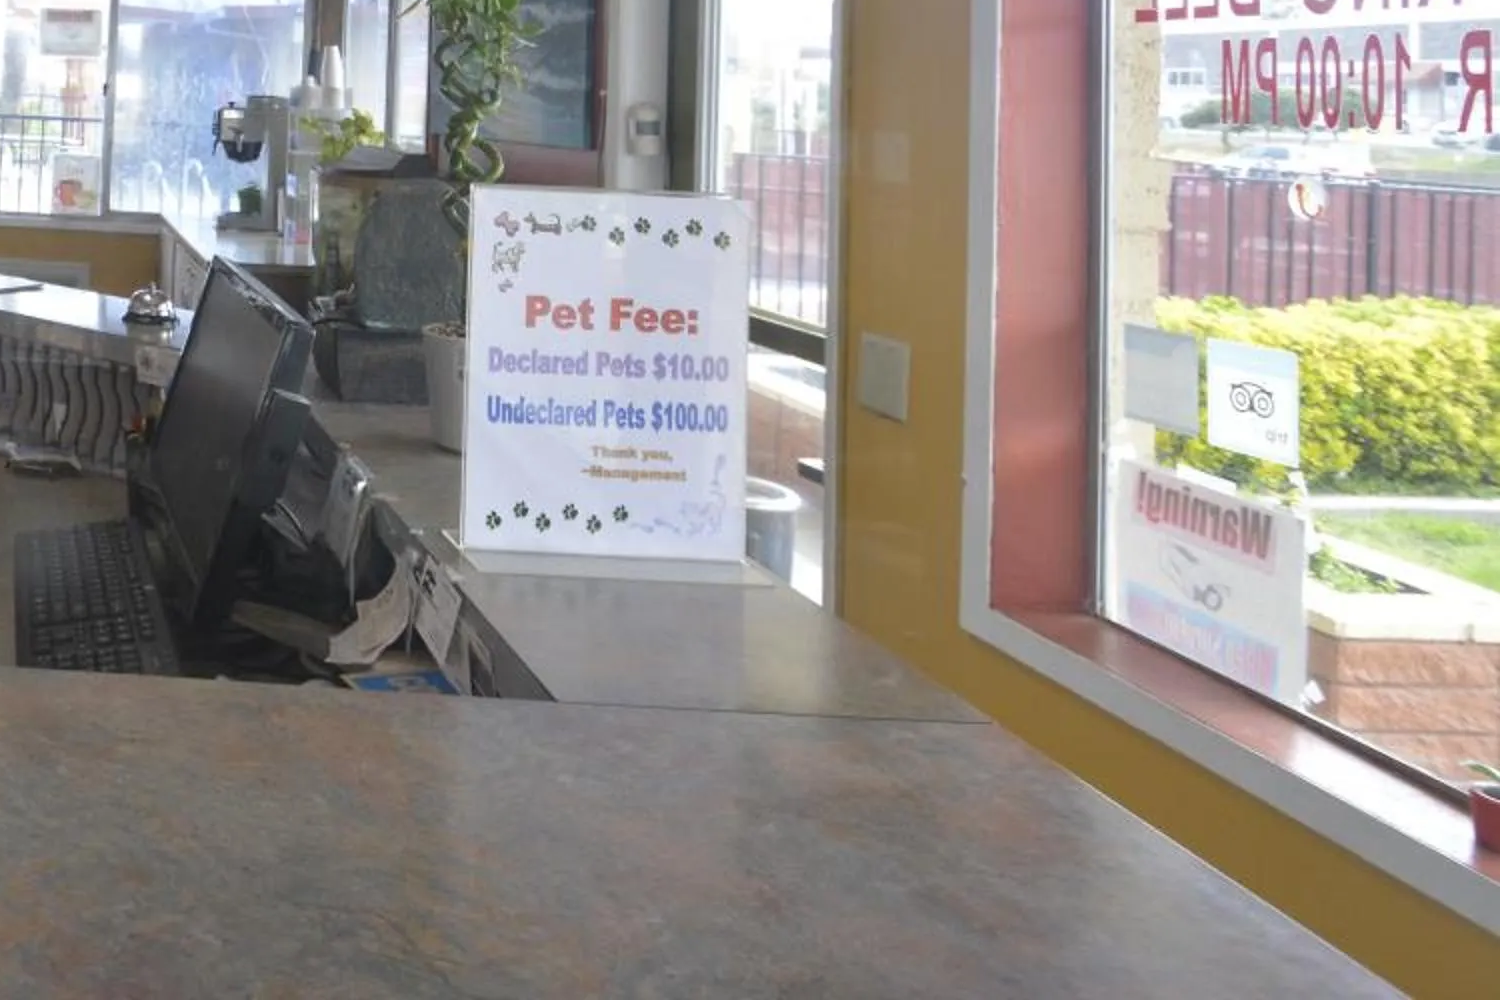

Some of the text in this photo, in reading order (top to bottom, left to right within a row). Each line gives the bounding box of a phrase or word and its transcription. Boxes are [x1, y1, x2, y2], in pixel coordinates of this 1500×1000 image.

[525, 295, 699, 335] Pet Fee:
[488, 346, 730, 382] Declared Pets $10.00
[487, 395, 729, 433] Undeclared Pets $100.00
[591, 446, 638, 459] Thank
